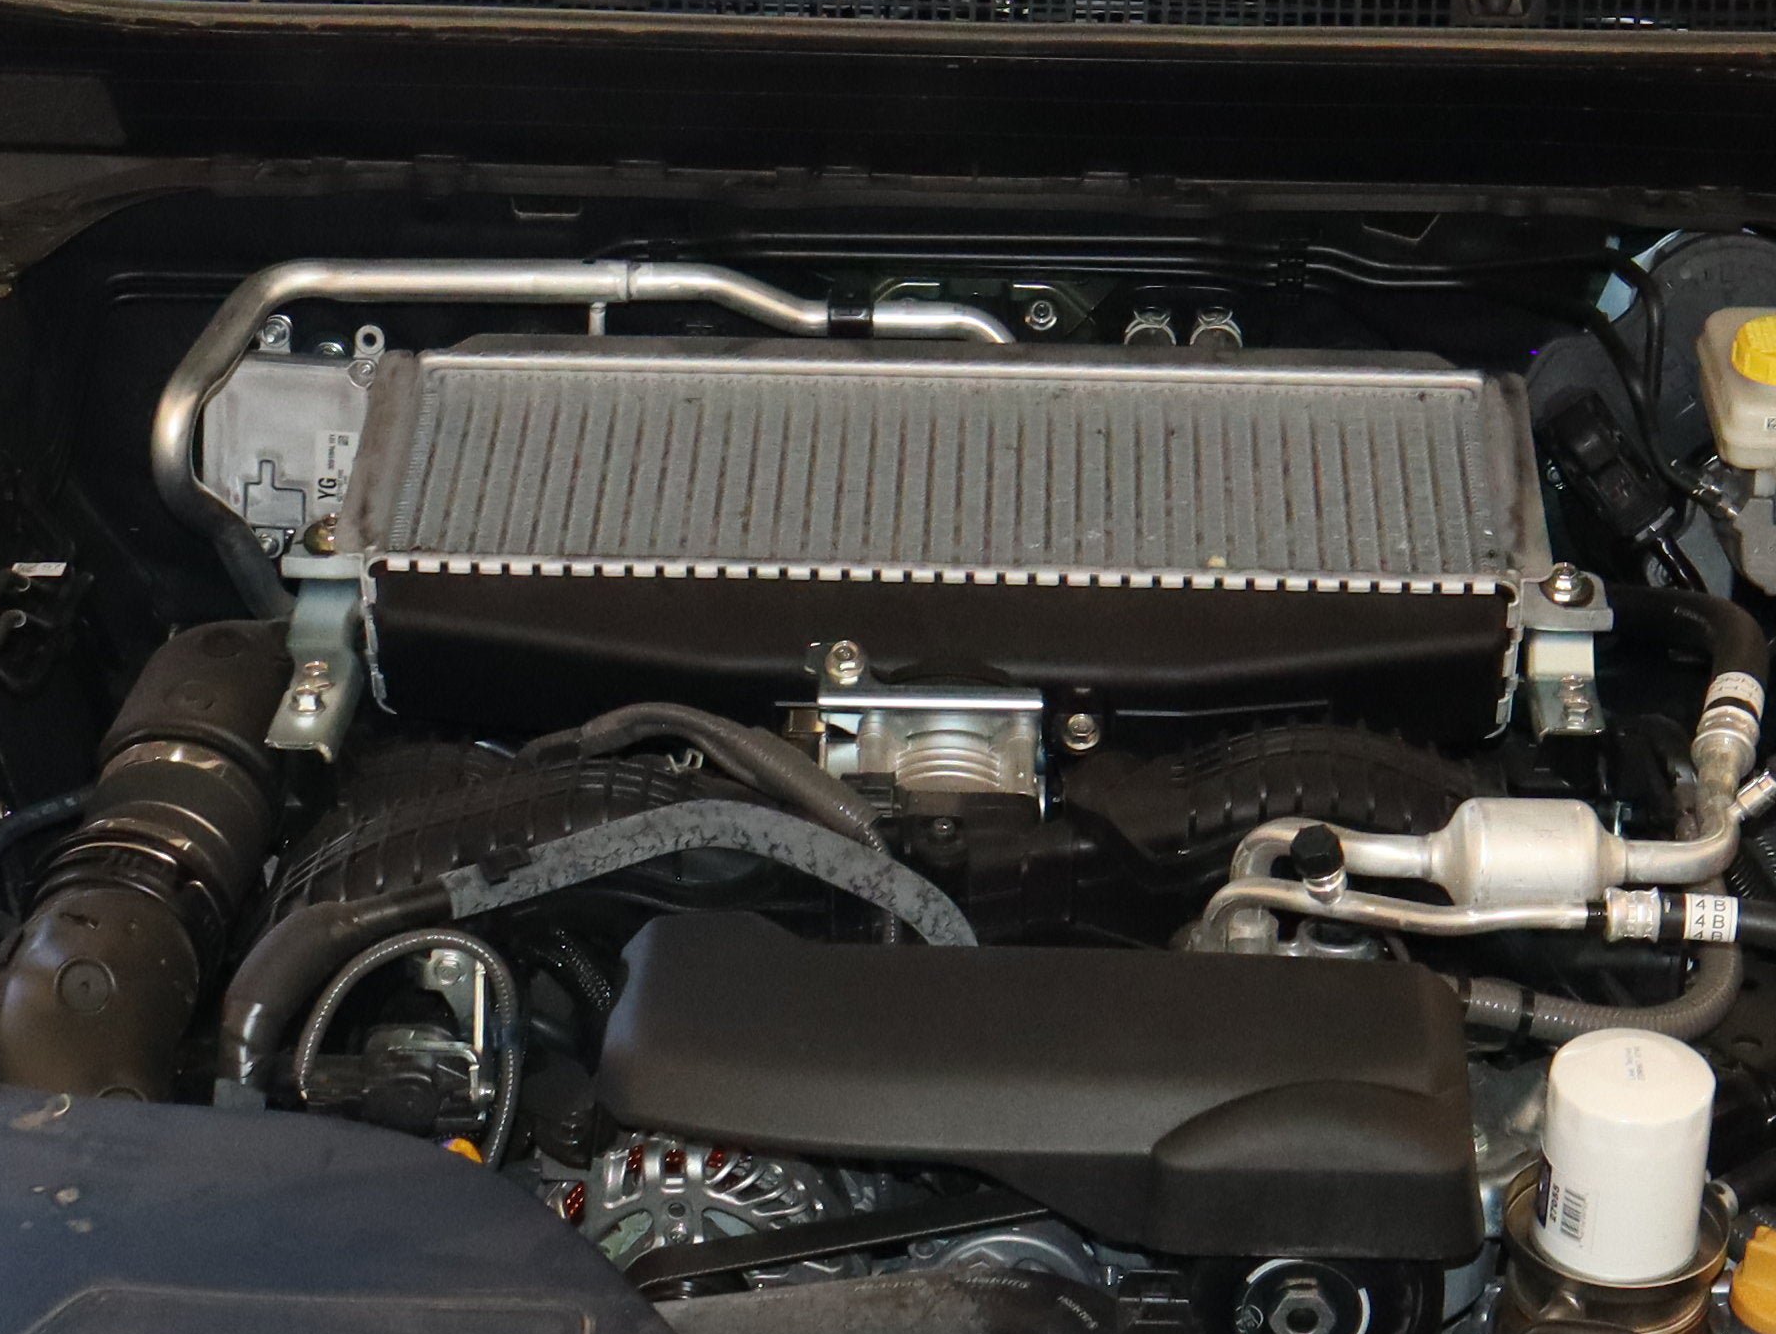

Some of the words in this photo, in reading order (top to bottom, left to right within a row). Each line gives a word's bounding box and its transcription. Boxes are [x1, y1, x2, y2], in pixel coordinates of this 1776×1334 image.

[317, 477, 337, 500] YG
[1695, 899, 1707, 911] 4
[1714, 899, 1726, 912] B
[1694, 914, 1706, 928] 4
[1712, 914, 1725, 929] B
